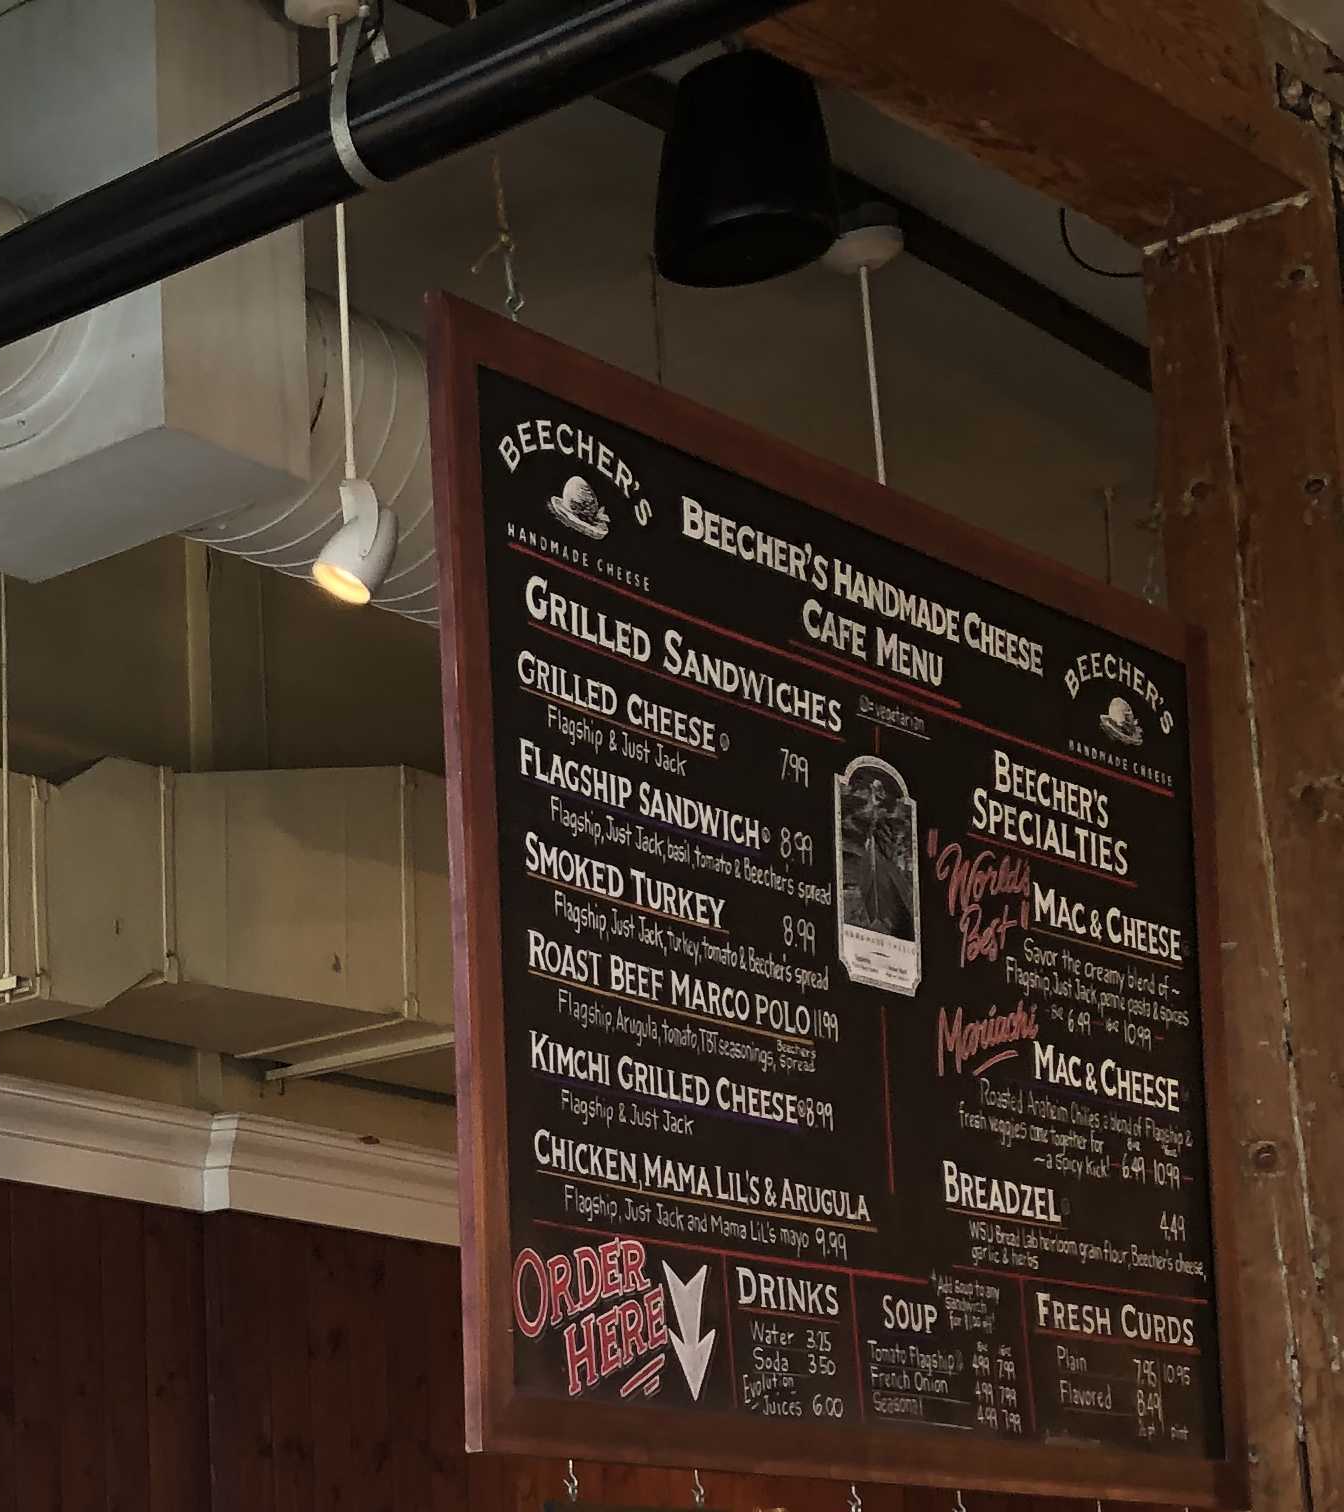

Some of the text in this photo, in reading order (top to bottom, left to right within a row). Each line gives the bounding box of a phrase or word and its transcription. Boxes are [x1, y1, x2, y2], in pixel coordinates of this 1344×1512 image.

[498, 419, 653, 526] BEECHER'S
[507, 522, 650, 592] HANDMADE CHEESE
[681, 495, 1044, 678] BEECHER'S HANDMADE CHEESE
[525, 575, 651, 662] GRILLED
[663, 629, 842, 733] SANDWICHES
[802, 599, 944, 687] CAFE MENU
[518, 650, 618, 715] GRILLED
[627, 693, 716, 752] CHEESE
[1064, 651, 1174, 735] BEECHER'S
[547, 704, 688, 777] Flagship & Just Jack
[1068, 738, 1128, 772] HANDMADE
[519, 737, 632, 809] FLAGSHIP
[639, 782, 761, 850] SANDWICH
[994, 750, 1109, 829] BEECHER'S
[605, 815, 632, 845] Just
[798, 882, 832, 907] spread
[972, 787, 1128, 876] SPECIALTIES
[525, 831, 624, 899] SMOKED
[630, 869, 726, 928] TURKEY
[783, 915, 816, 958] 8.99
[1033, 881, 1183, 961] MAC & CHEESE
[528, 929, 602, 986] ROAST
[610, 954, 663, 1001] BEEF
[671, 969, 750, 1021] MARCO
[755, 993, 811, 1035] POLO
[611, 908, 634, 939] Just
[703, 937, 738, 970] tomato
[794, 965, 829, 993] spread
[1023, 937, 1170, 999] Savor the creamy blend of
[938, 1000, 1039, 1077] Mariachi
[1033, 1040, 1180, 1112] MAC & CHEESE
[529, 1030, 798, 1125] KIMCHI GRILLED CHEESE
[561, 1088, 694, 1136] Flagship & Just Jack
[533, 1128, 643, 1191] CHICKEN,
[644, 1152, 712, 1198] MAMA
[764, 1177, 777, 1208] &
[781, 1179, 872, 1223] ARUGULA
[942, 1160, 1062, 1223] BREADZEL
[624, 1197, 652, 1225] Just
[656, 1202, 685, 1232] Jack
[688, 1209, 708, 1234] and
[710, 1214, 747, 1240] Mama
[780, 1227, 809, 1258] mayo
[815, 1226, 848, 1262] 9.99
[514, 1236, 651, 1338] ORDER
[736, 1266, 840, 1316] DRINKS
[882, 1294, 939, 1334] SOUP
[1035, 1291, 1112, 1336] FRESH
[1120, 1303, 1195, 1347] CURDS
[564, 1284, 671, 1397] HERE
[750, 1319, 795, 1346] Water
[752, 1347, 790, 1372] Soda
[909, 1345, 955, 1377] Flagship
[1056, 1345, 1088, 1374] Plain
[762, 1394, 803, 1417] Juices
[870, 1365, 949, 1394] French Onion
[1059, 1379, 1113, 1411] Flavored
